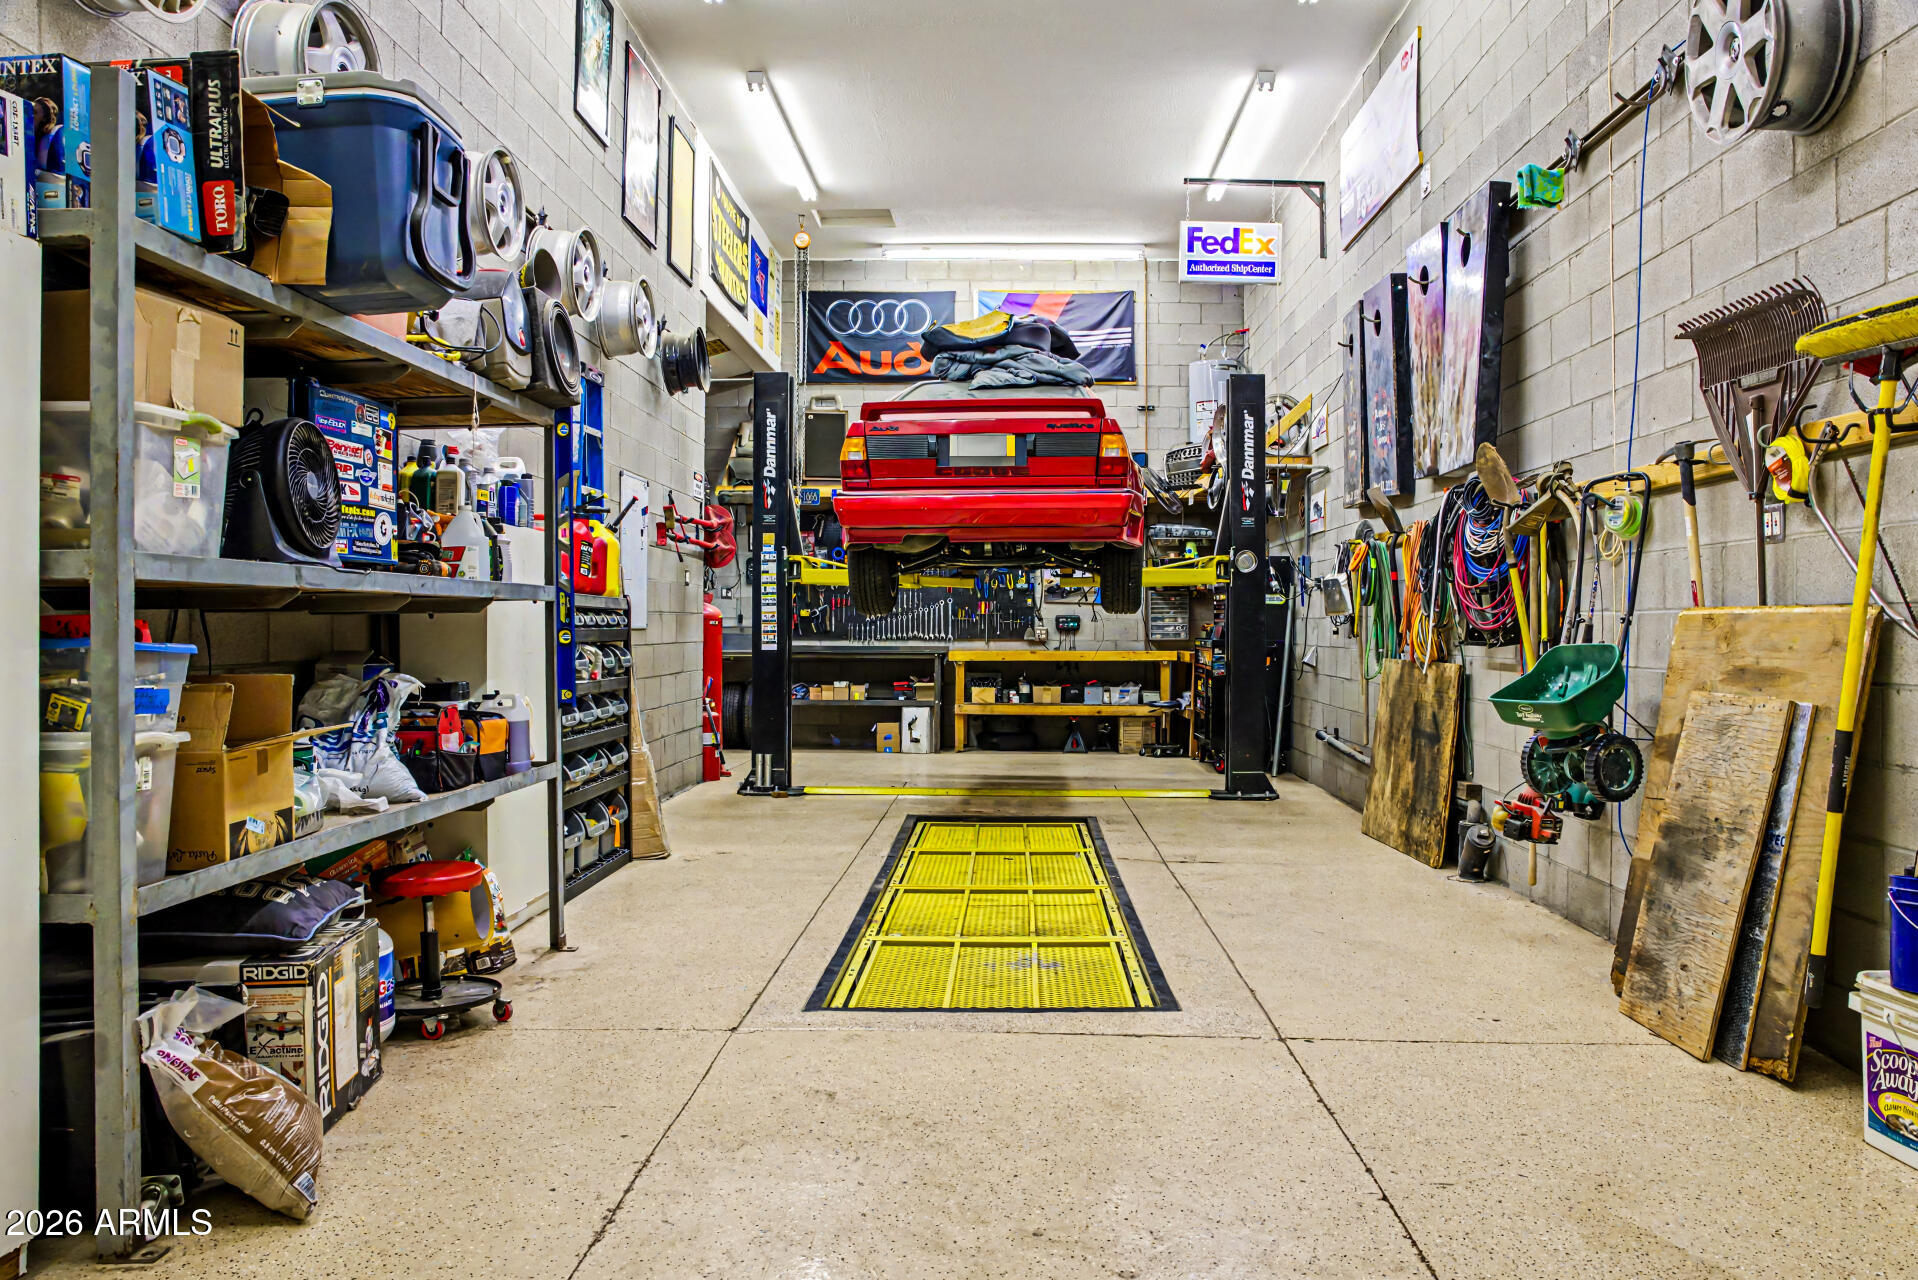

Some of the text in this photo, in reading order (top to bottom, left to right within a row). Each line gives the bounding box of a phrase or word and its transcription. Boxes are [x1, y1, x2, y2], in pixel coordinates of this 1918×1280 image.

[0, 58, 57, 75] NTEX
[207, 79, 224, 169] ULTRAPLUS
[214, 187, 229, 232] TORO
[1187, 226, 1275, 255] FedEx
[1189, 263, 1273, 275] Authorized ShipCenter
[812, 340, 934, 377] Aud
[763, 409, 777, 478] Dannmar
[1242, 411, 1255, 480] Dannmar
[188, 849, 217, 863] Pasta
[242, 966, 309, 981] RIDGID
[317, 971, 332, 1119] RIDGID
[1870, 1048, 1918, 1078] Scoop
[1872, 1068, 1918, 1102] Away
